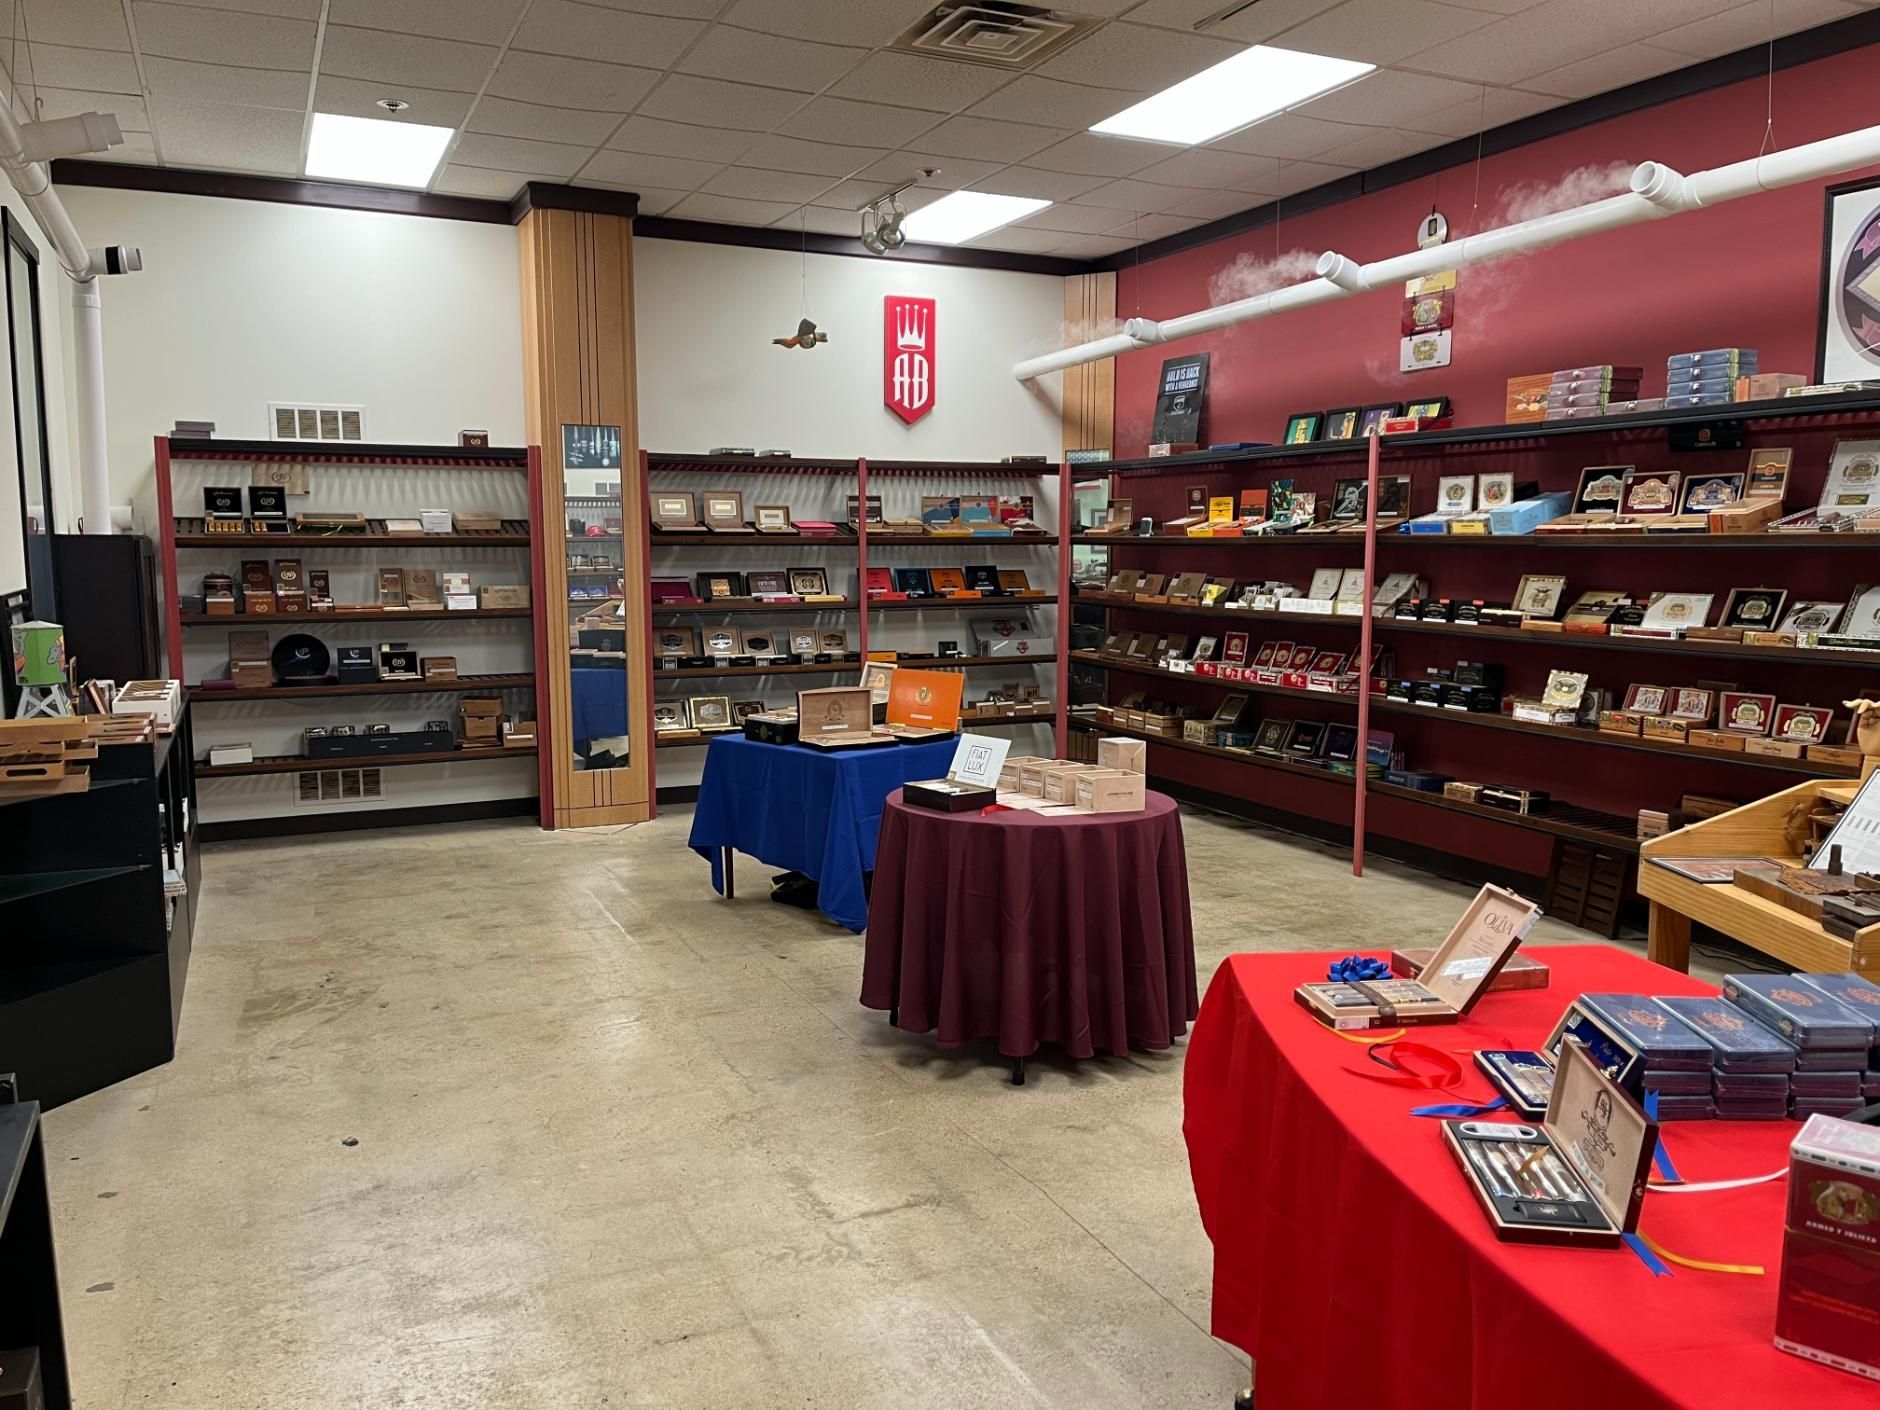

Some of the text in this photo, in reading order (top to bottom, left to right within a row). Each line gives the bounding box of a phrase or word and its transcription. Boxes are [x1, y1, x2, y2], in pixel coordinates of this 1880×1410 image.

[1186, 366, 1200, 379] BACK
[971, 748, 988, 760] FIAT
[967, 760, 984, 773] LUX
